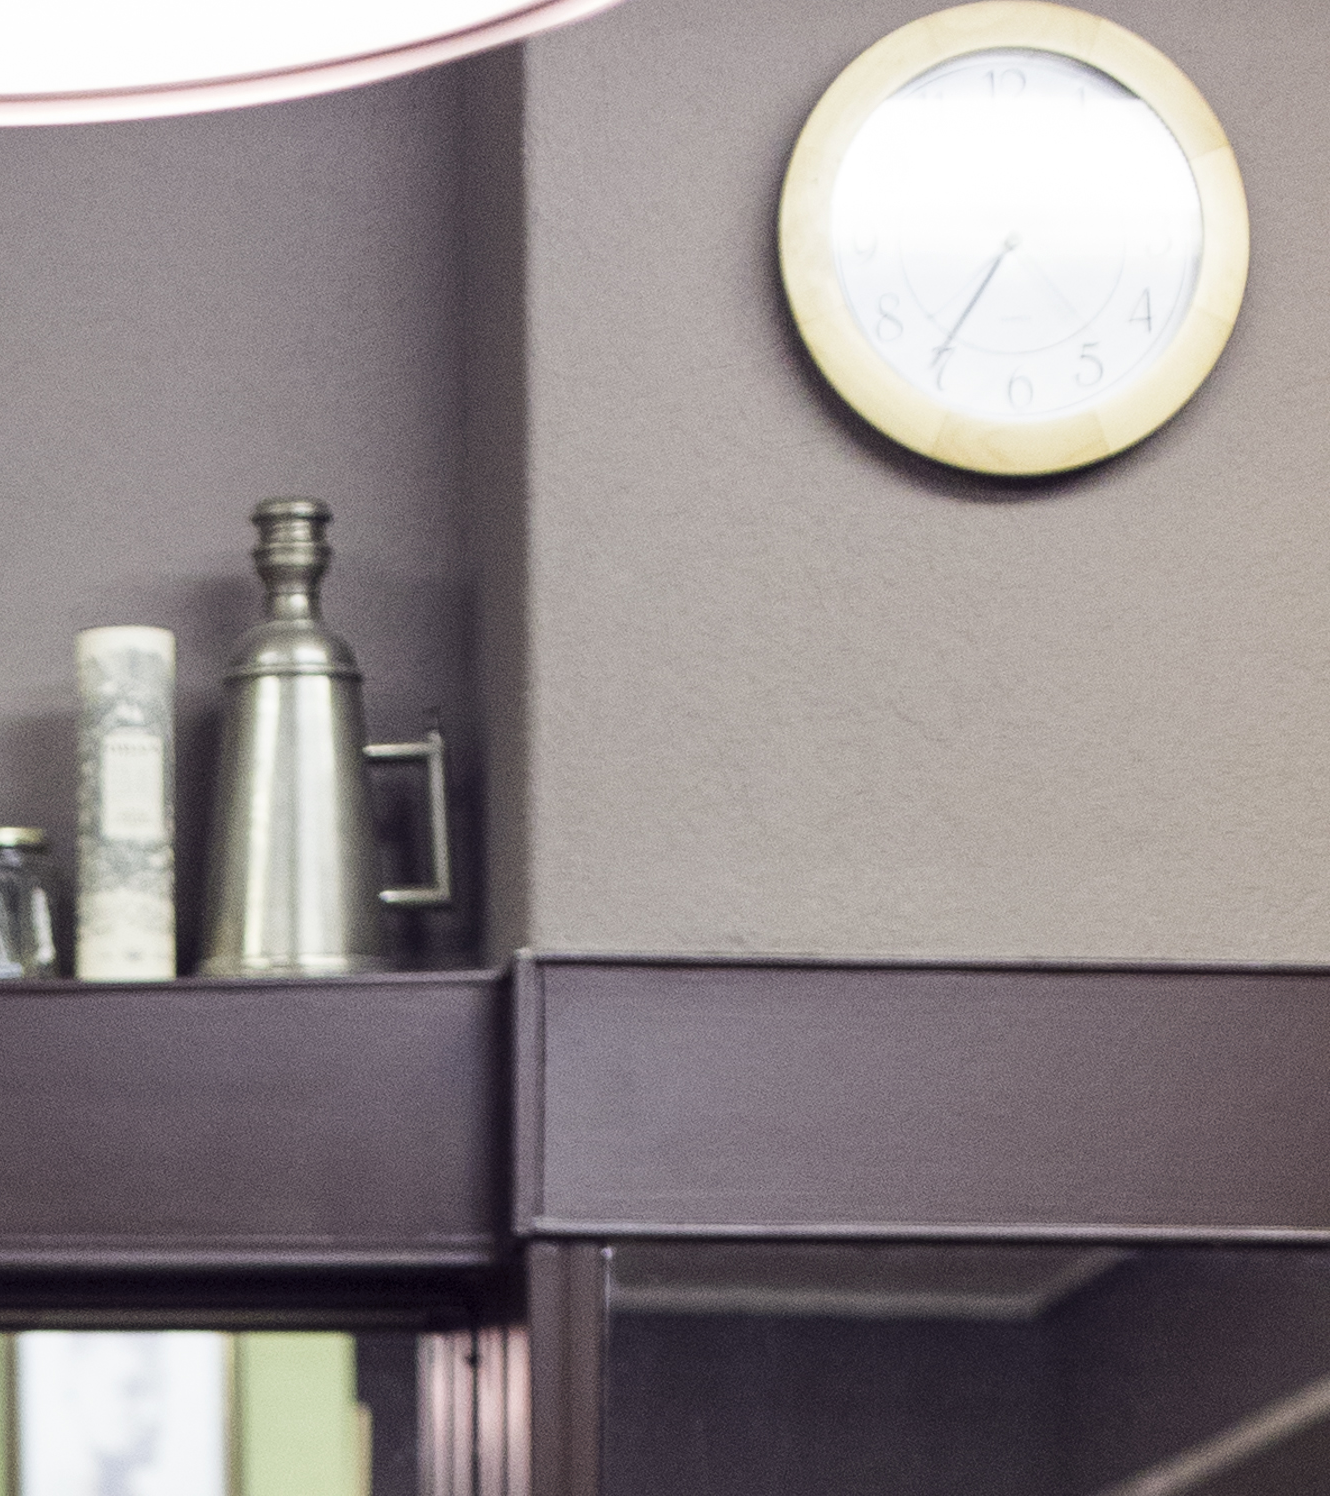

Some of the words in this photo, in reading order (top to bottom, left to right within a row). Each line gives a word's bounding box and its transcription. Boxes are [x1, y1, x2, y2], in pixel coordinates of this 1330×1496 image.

[875, 291, 905, 343] 8
[1126, 285, 1154, 334] 4
[1006, 364, 1035, 412] 6
[1073, 340, 1107, 388] 5
